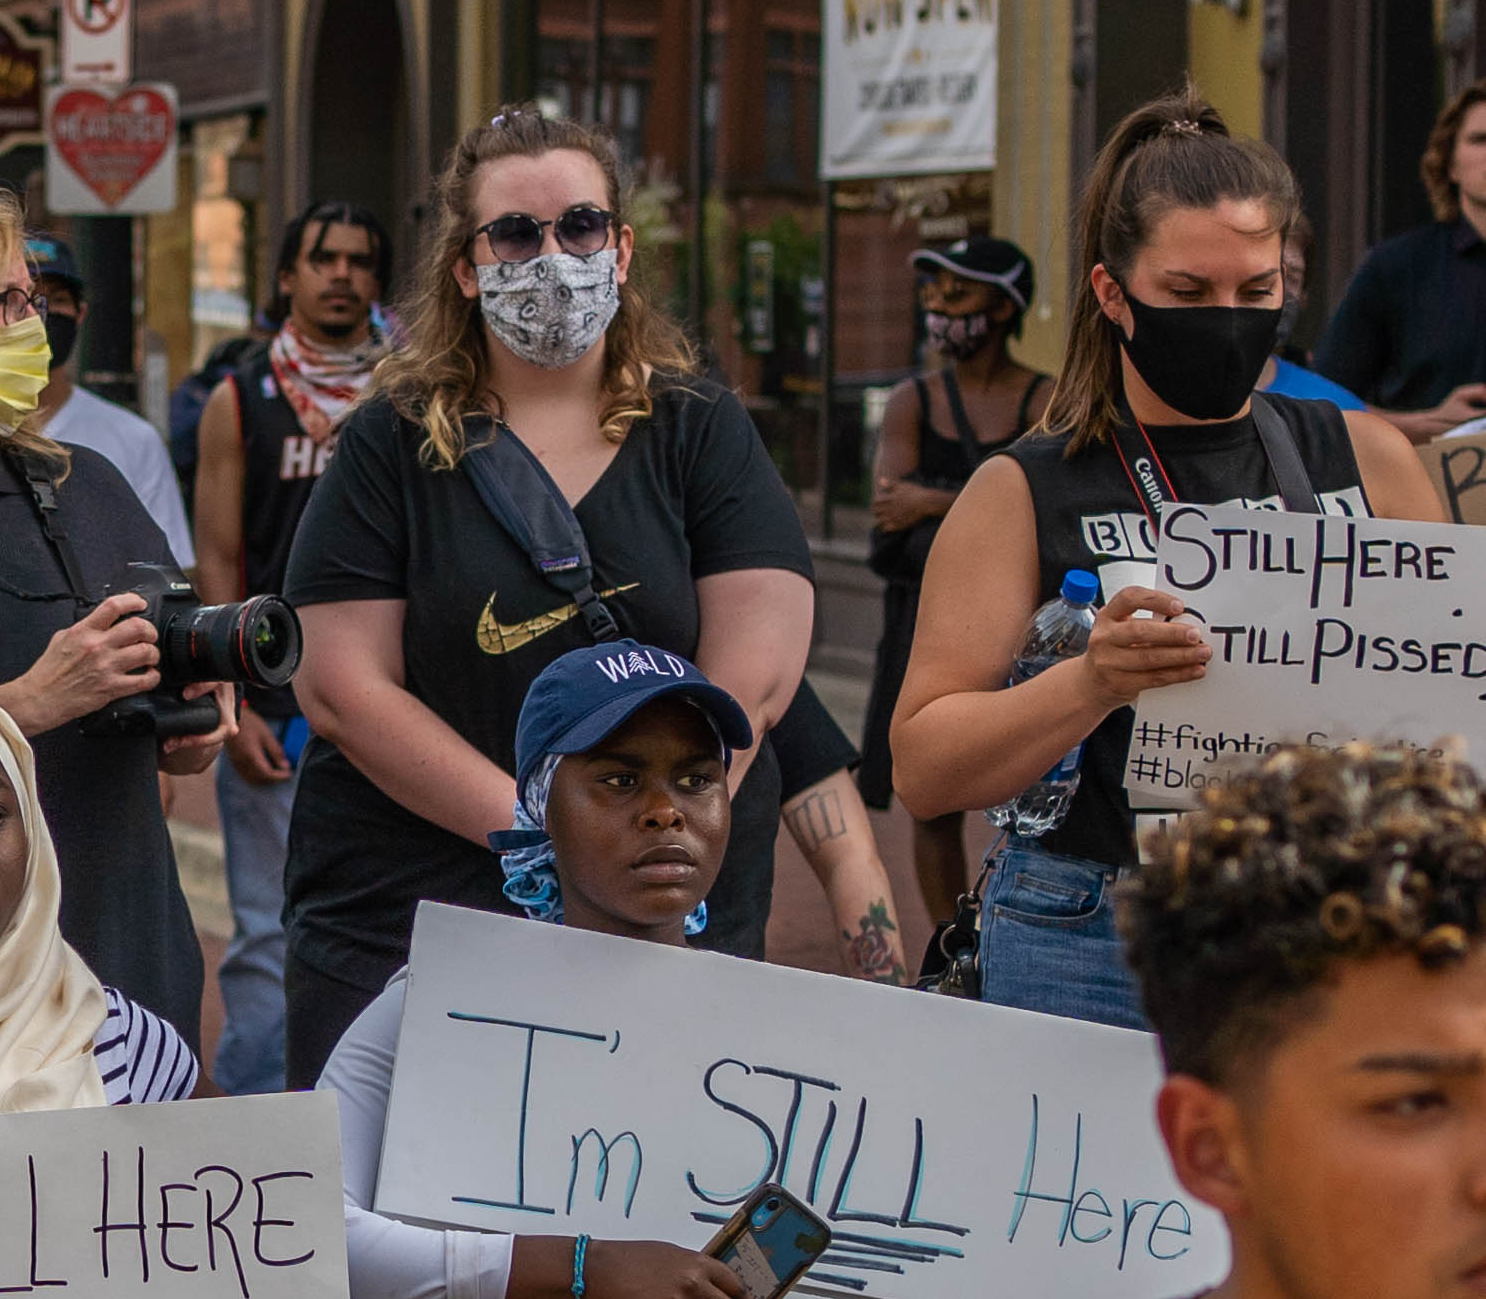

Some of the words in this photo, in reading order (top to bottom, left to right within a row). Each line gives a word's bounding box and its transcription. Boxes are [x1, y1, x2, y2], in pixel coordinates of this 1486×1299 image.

[92, 1145, 316, 1299] HERE
[445, 1010, 643, 1218] I'm
[685, 1058, 970, 1236] STILL
[1006, 1093, 1192, 1272] Here
